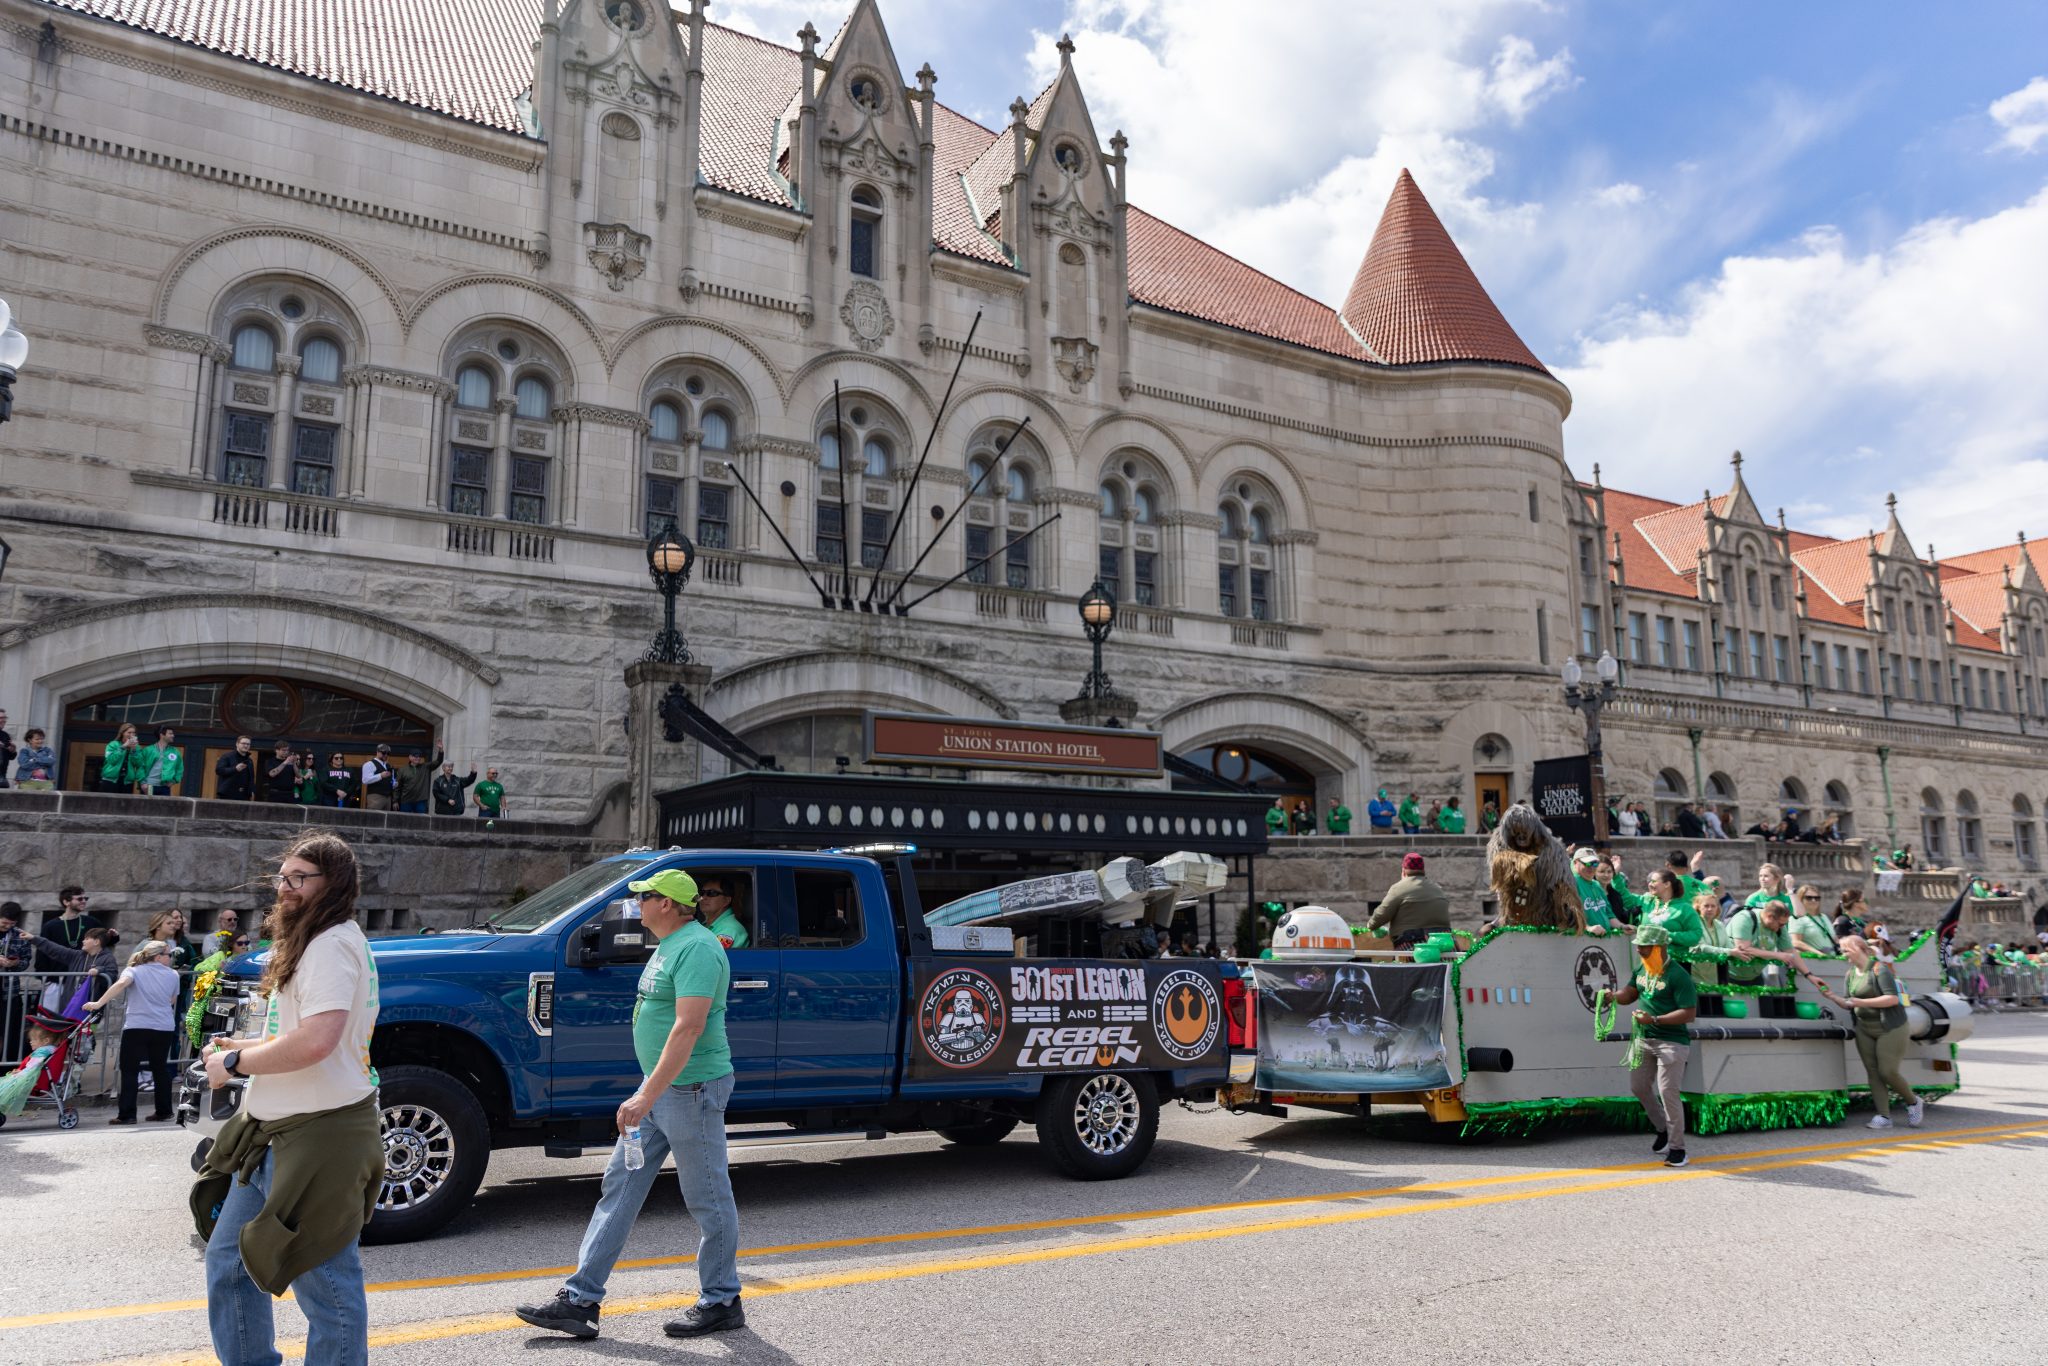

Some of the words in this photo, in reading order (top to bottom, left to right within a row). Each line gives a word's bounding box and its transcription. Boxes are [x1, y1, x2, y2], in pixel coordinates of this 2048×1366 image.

[963, 729, 992, 737] LOUIS
[943, 735, 992, 750] UNION
[995, 738, 1052, 754] STATION
[1056, 743, 1101, 758] HOTEL
[1540, 795, 1584, 808] STATION
[1544, 788, 1579, 799] UNION
[1545, 804, 1581, 816] HOTEL
[1010, 966, 1075, 1001] 501ST
[1076, 967, 1147, 1001] LEGION
[1157, 974, 1180, 1006] REBEL
[1185, 973, 1216, 1005] LEGION
[1067, 1009, 1097, 1019] AND
[1023, 1026, 1138, 1047] REBEL
[927, 1034, 956, 1061] 501ST
[959, 1032, 998, 1063] LEGION
